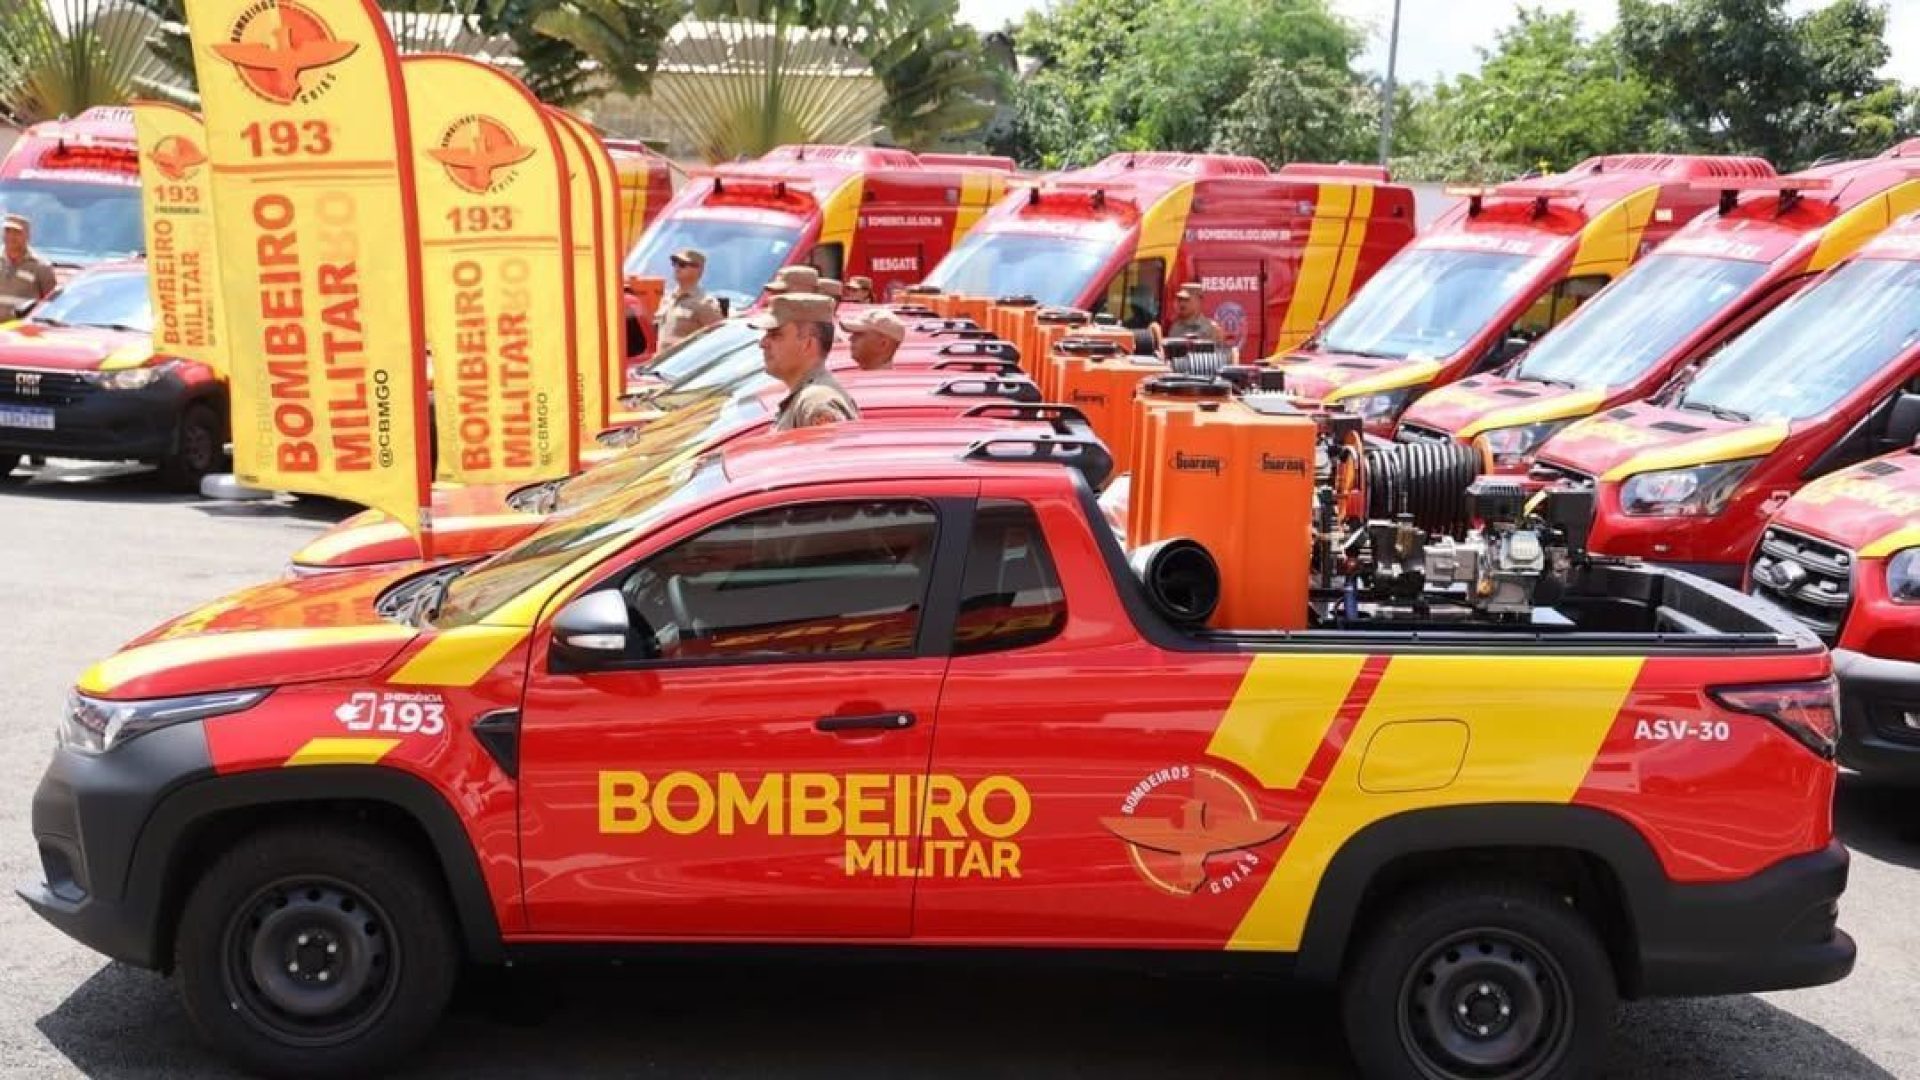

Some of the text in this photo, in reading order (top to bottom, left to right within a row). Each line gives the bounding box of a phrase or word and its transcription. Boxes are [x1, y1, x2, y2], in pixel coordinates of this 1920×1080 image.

[240, 119, 333, 158] 193
[154, 186, 200, 204] 193
[445, 205, 513, 233] 193
[154, 219, 181, 345] BOMBEIRO
[872, 256, 918, 271] RESGATE
[1201, 276, 1259, 291] RESGATE
[181, 251, 205, 347] MILITAR
[253, 193, 319, 474] BOMBEIRO
[317, 260, 373, 472] MILITAR
[452, 260, 493, 471] BOMBEIRO
[497, 312, 534, 468] MILITAR
[373, 368, 394, 468] @CBMGO
[536, 391, 554, 467] @CBMGO
[378, 702, 445, 735] 193
[1634, 720, 1730, 742] ASV-30
[599, 770, 1032, 838] BOMBEIRO
[1121, 765, 1190, 815] BOMBEIROS
[845, 839, 1022, 879] MILITAR
[1210, 851, 1261, 895] GOIÁS
